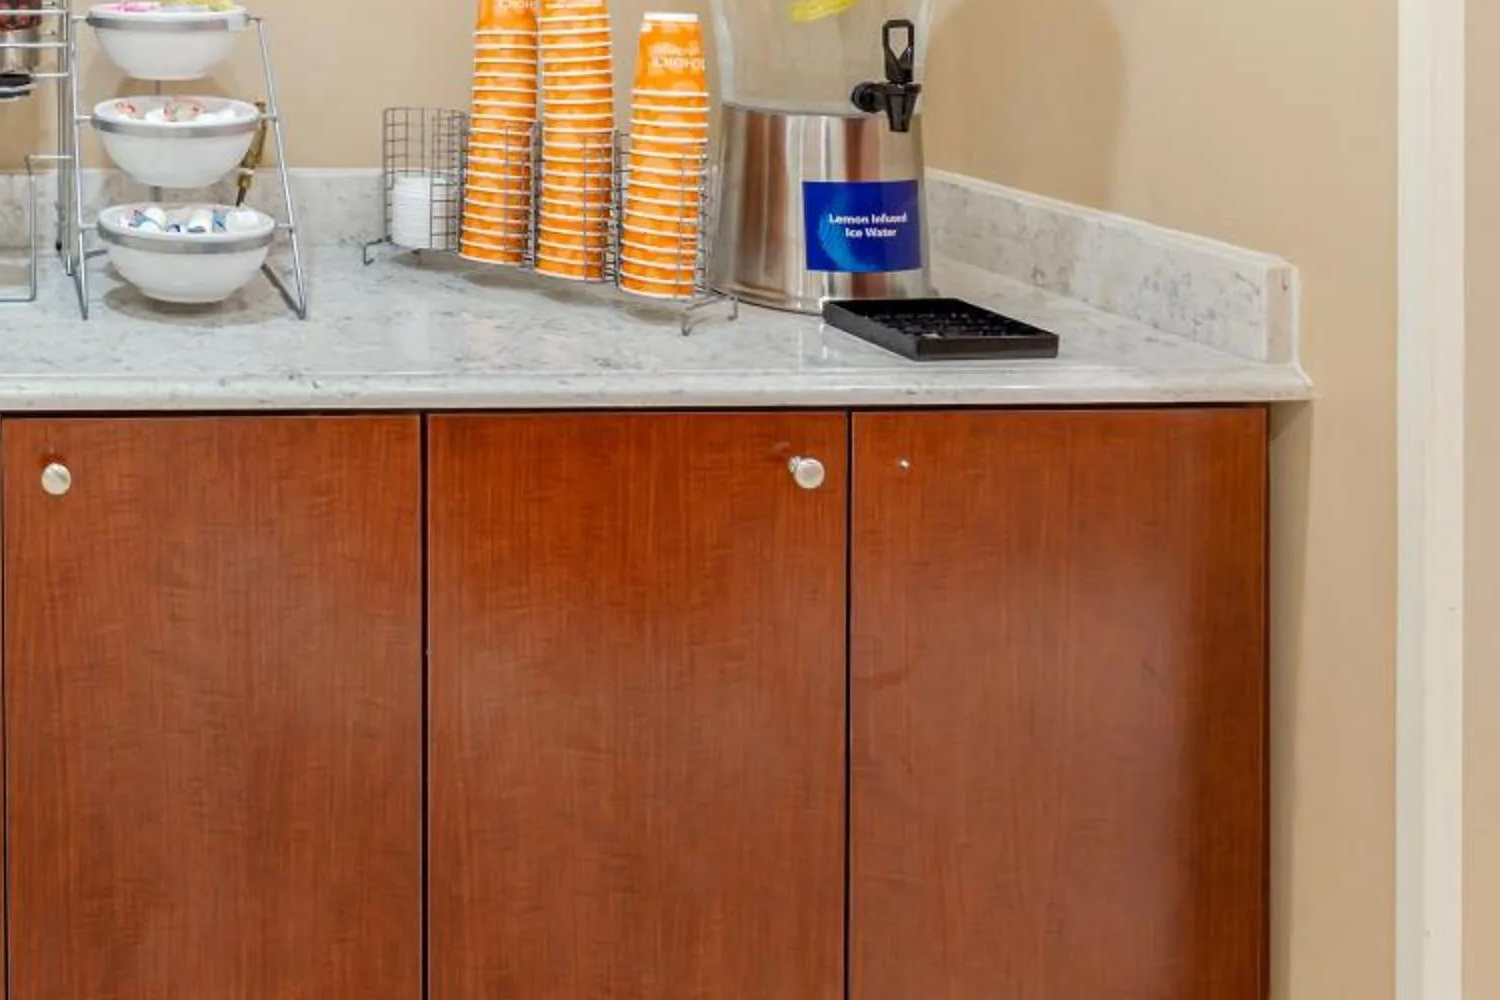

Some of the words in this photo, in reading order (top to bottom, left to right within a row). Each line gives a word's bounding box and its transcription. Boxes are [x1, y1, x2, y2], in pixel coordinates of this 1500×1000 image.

[828, 212, 869, 225] Lemon
[871, 211, 908, 224] Infused
[845, 227, 863, 238] Ice
[865, 227, 898, 238] Water
